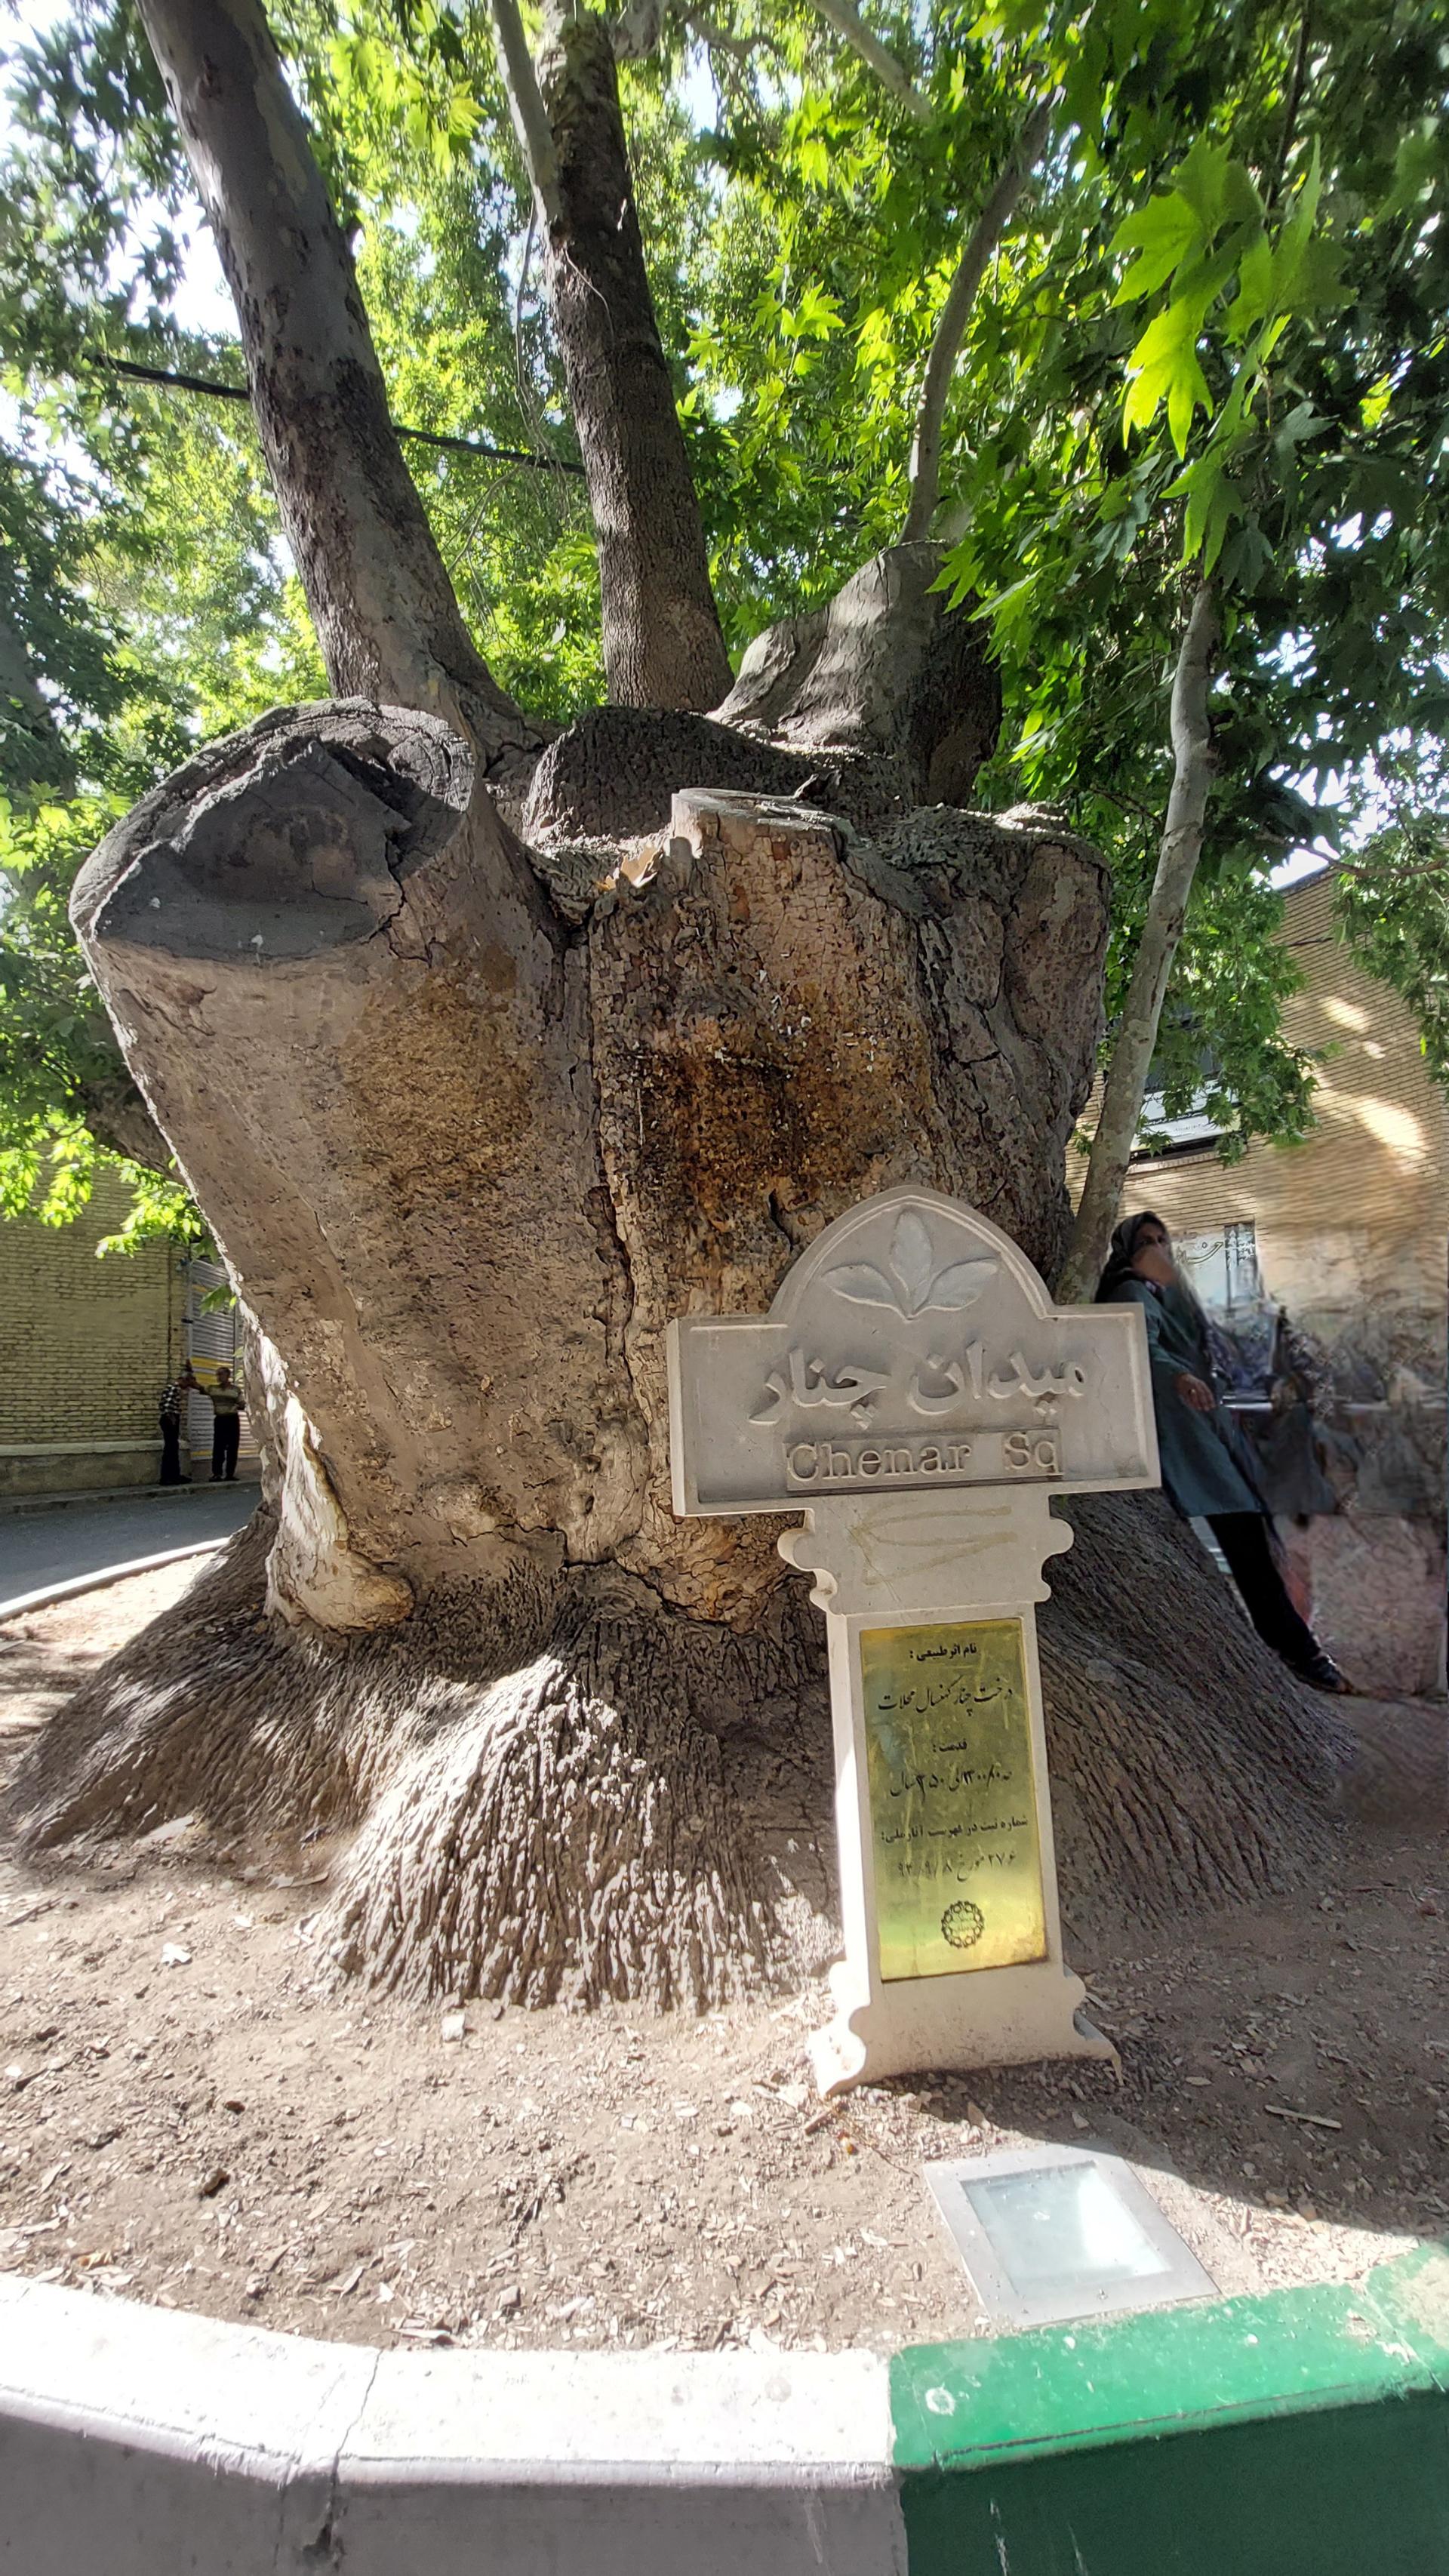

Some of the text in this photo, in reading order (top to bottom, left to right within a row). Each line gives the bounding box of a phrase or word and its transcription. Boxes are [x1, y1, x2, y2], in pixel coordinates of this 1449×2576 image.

[749, 1341, 1085, 1430] میدان چنار
[786, 1432, 1058, 1482] Chenar Sq
[964, 1642, 977, 1658] نام
[878, 1674, 1014, 1717] درخت چنار کهنسال محلات
[967, 1823, 978, 1836] در
[1001, 1814, 1028, 1832] شماره
